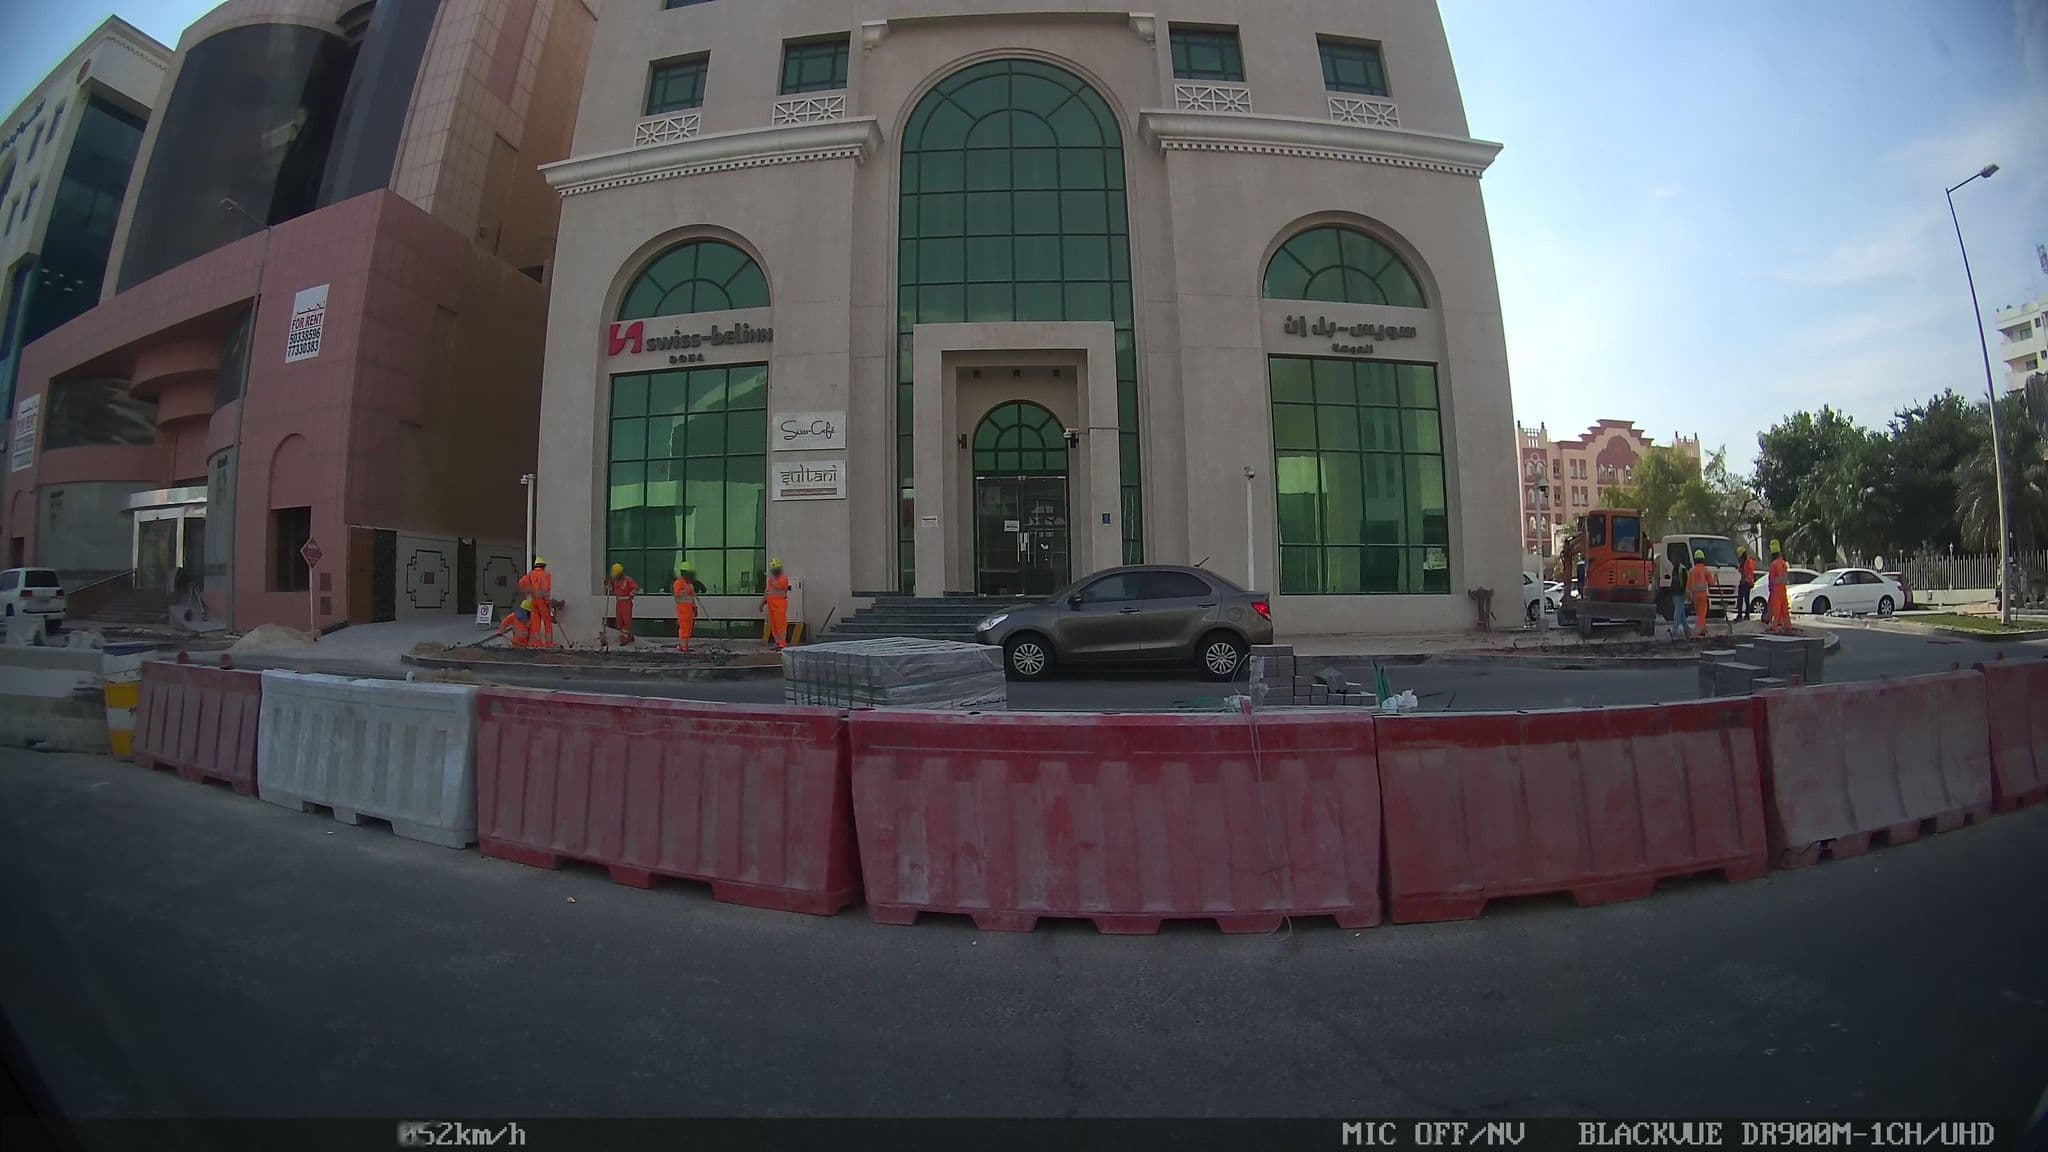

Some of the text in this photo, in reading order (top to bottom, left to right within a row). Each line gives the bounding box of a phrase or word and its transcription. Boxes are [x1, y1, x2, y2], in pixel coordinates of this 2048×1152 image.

[292, 312, 323, 330] FOR RENT
[669, 353, 706, 365] DOHA
